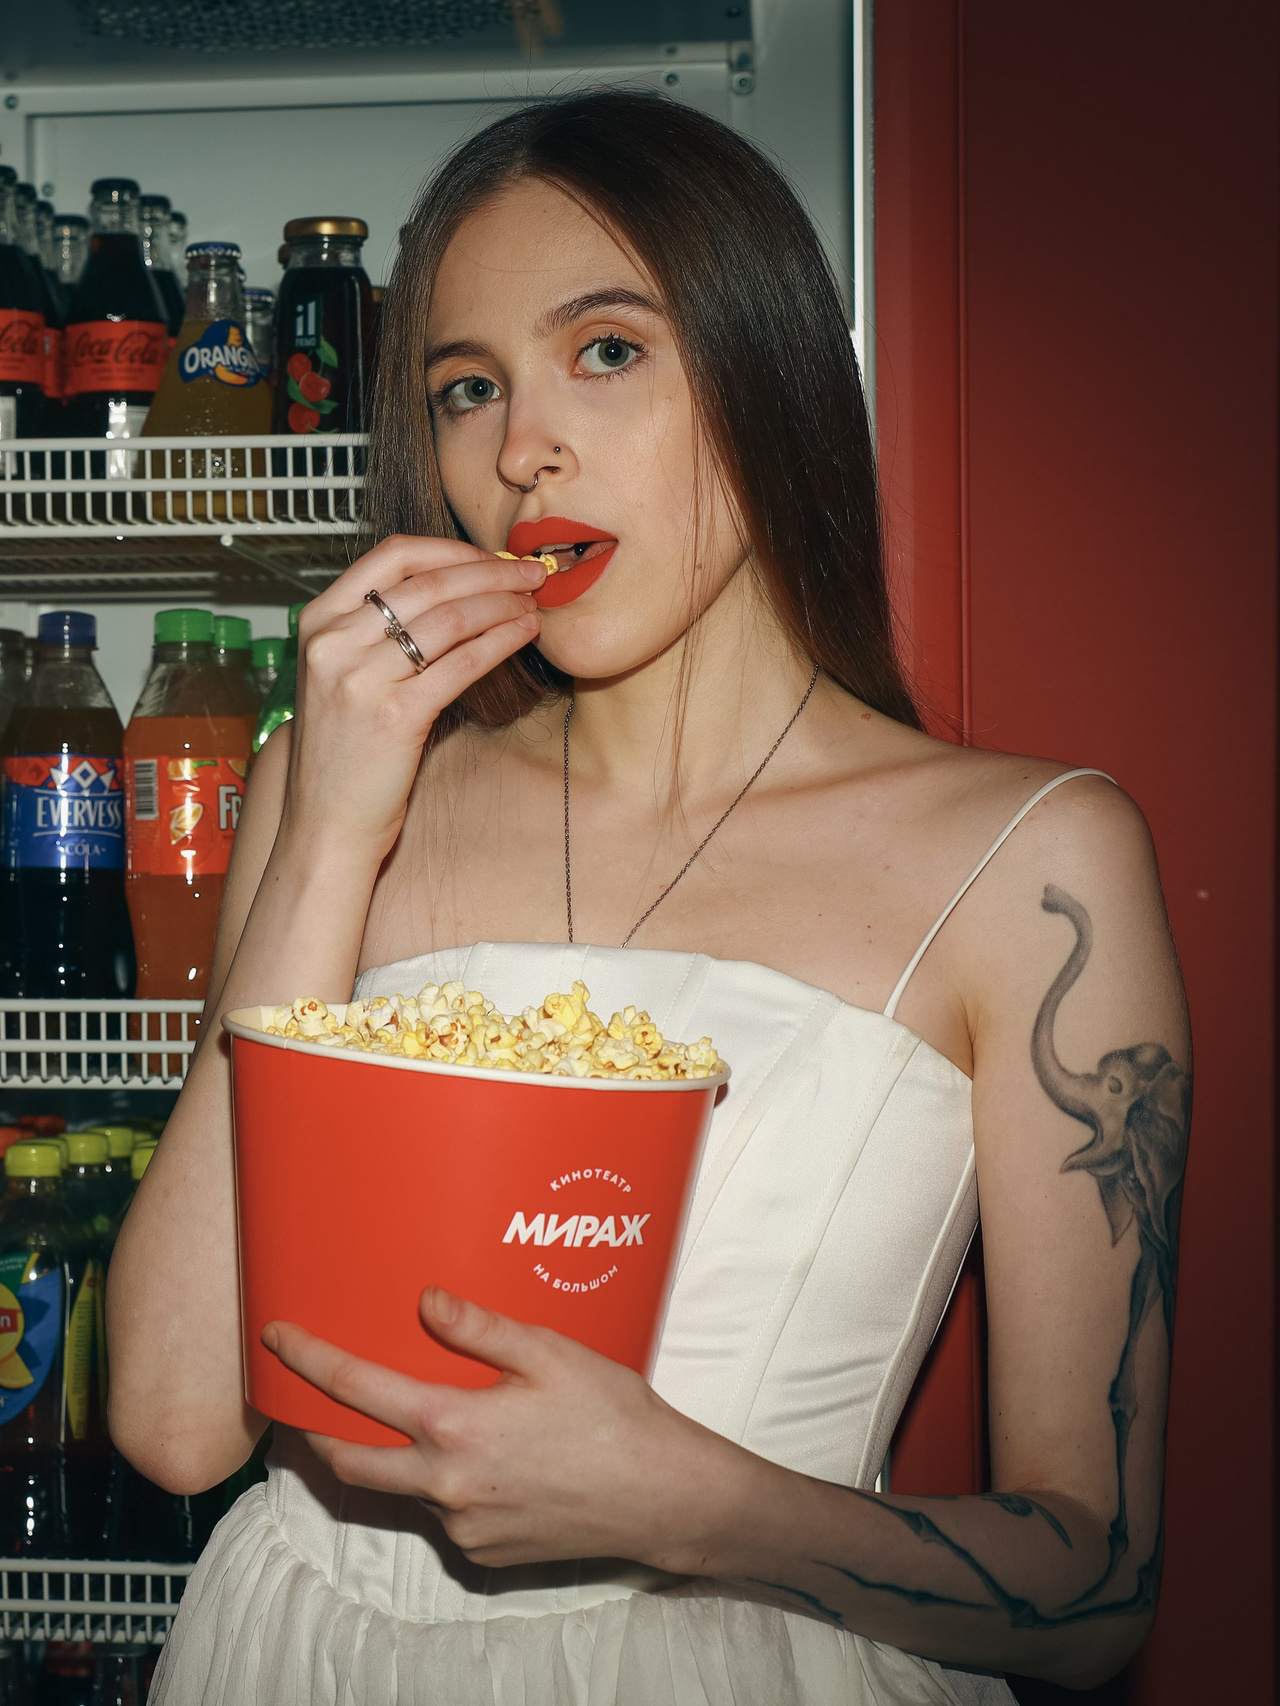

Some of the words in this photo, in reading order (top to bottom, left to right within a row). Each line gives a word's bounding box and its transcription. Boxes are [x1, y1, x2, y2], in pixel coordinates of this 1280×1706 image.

[36, 796, 121, 829] EVERVESS
[550, 1168, 632, 1193] КИНОТЕАТР
[502, 1211, 651, 1248] МИРАЖ
[533, 1263, 550, 1282] НА
[552, 1265, 618, 1293] БОЛЬШОМ
